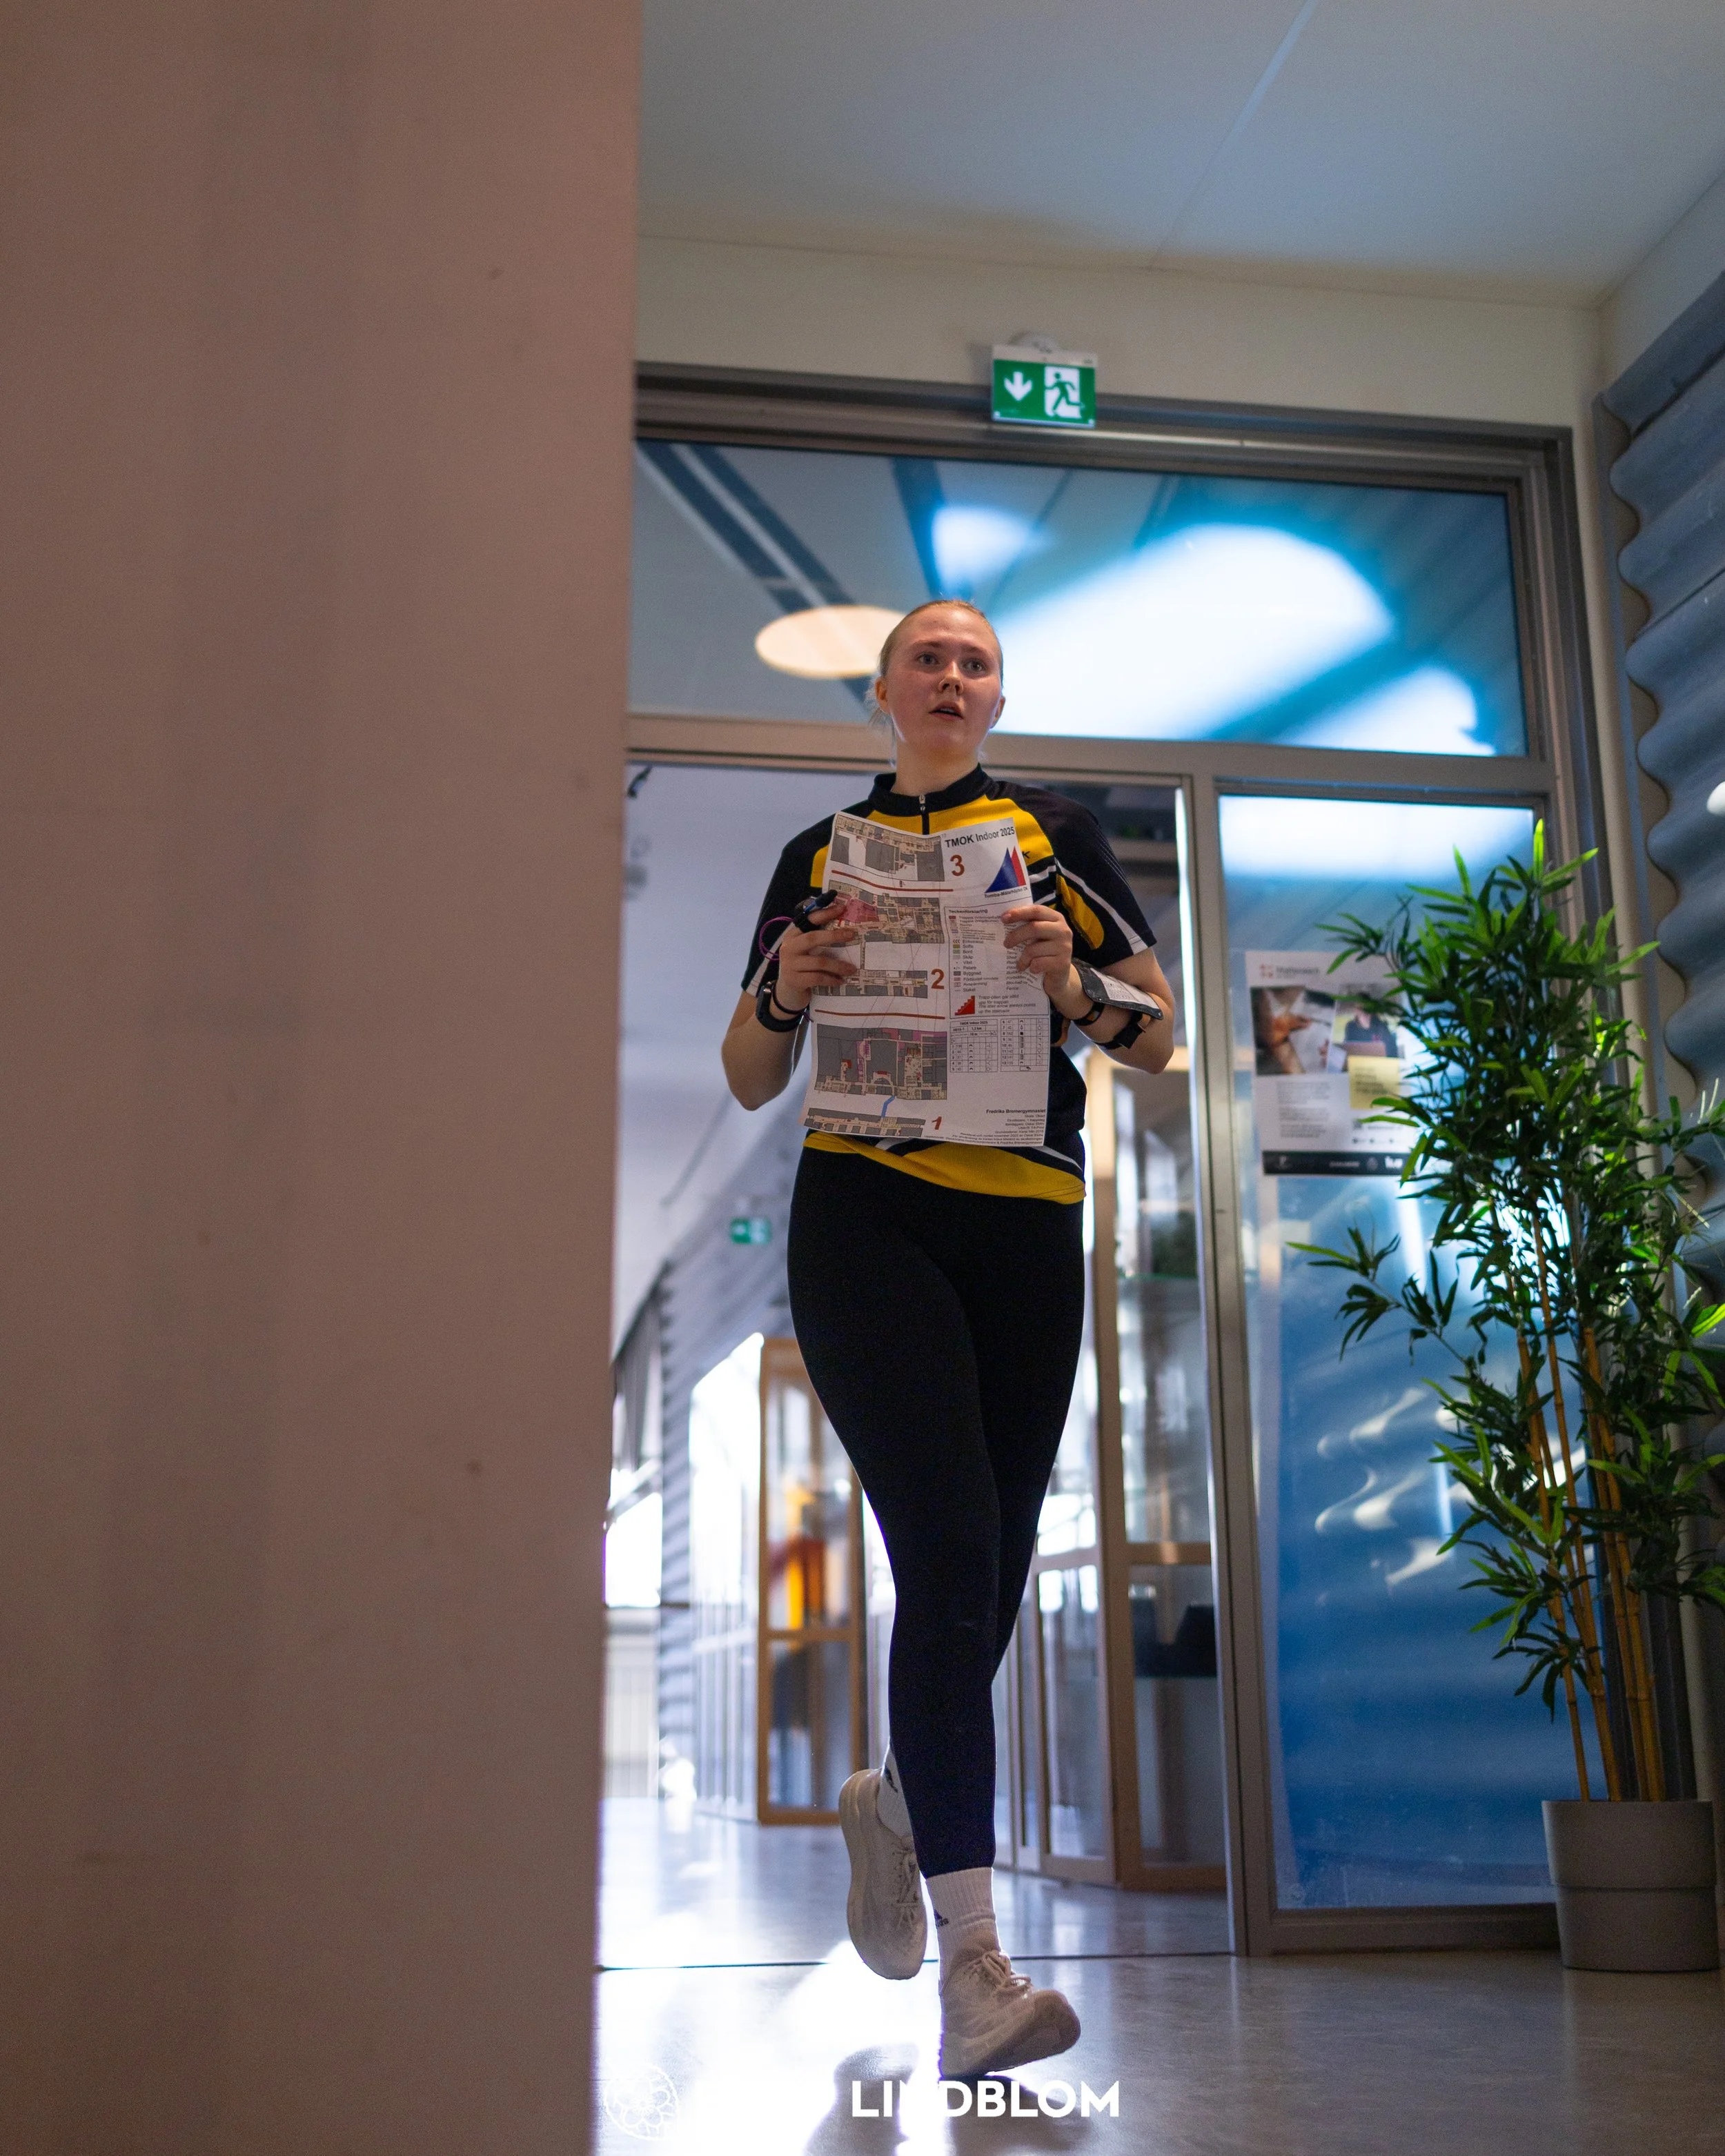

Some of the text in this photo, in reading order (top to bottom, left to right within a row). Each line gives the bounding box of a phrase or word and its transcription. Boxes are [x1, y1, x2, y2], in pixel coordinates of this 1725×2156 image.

[945, 827, 1016, 848] TMOK Indoor 2025
[950, 854, 965, 877] 3
[931, 969, 945, 989] 2
[931, 1116, 943, 1131] 1
